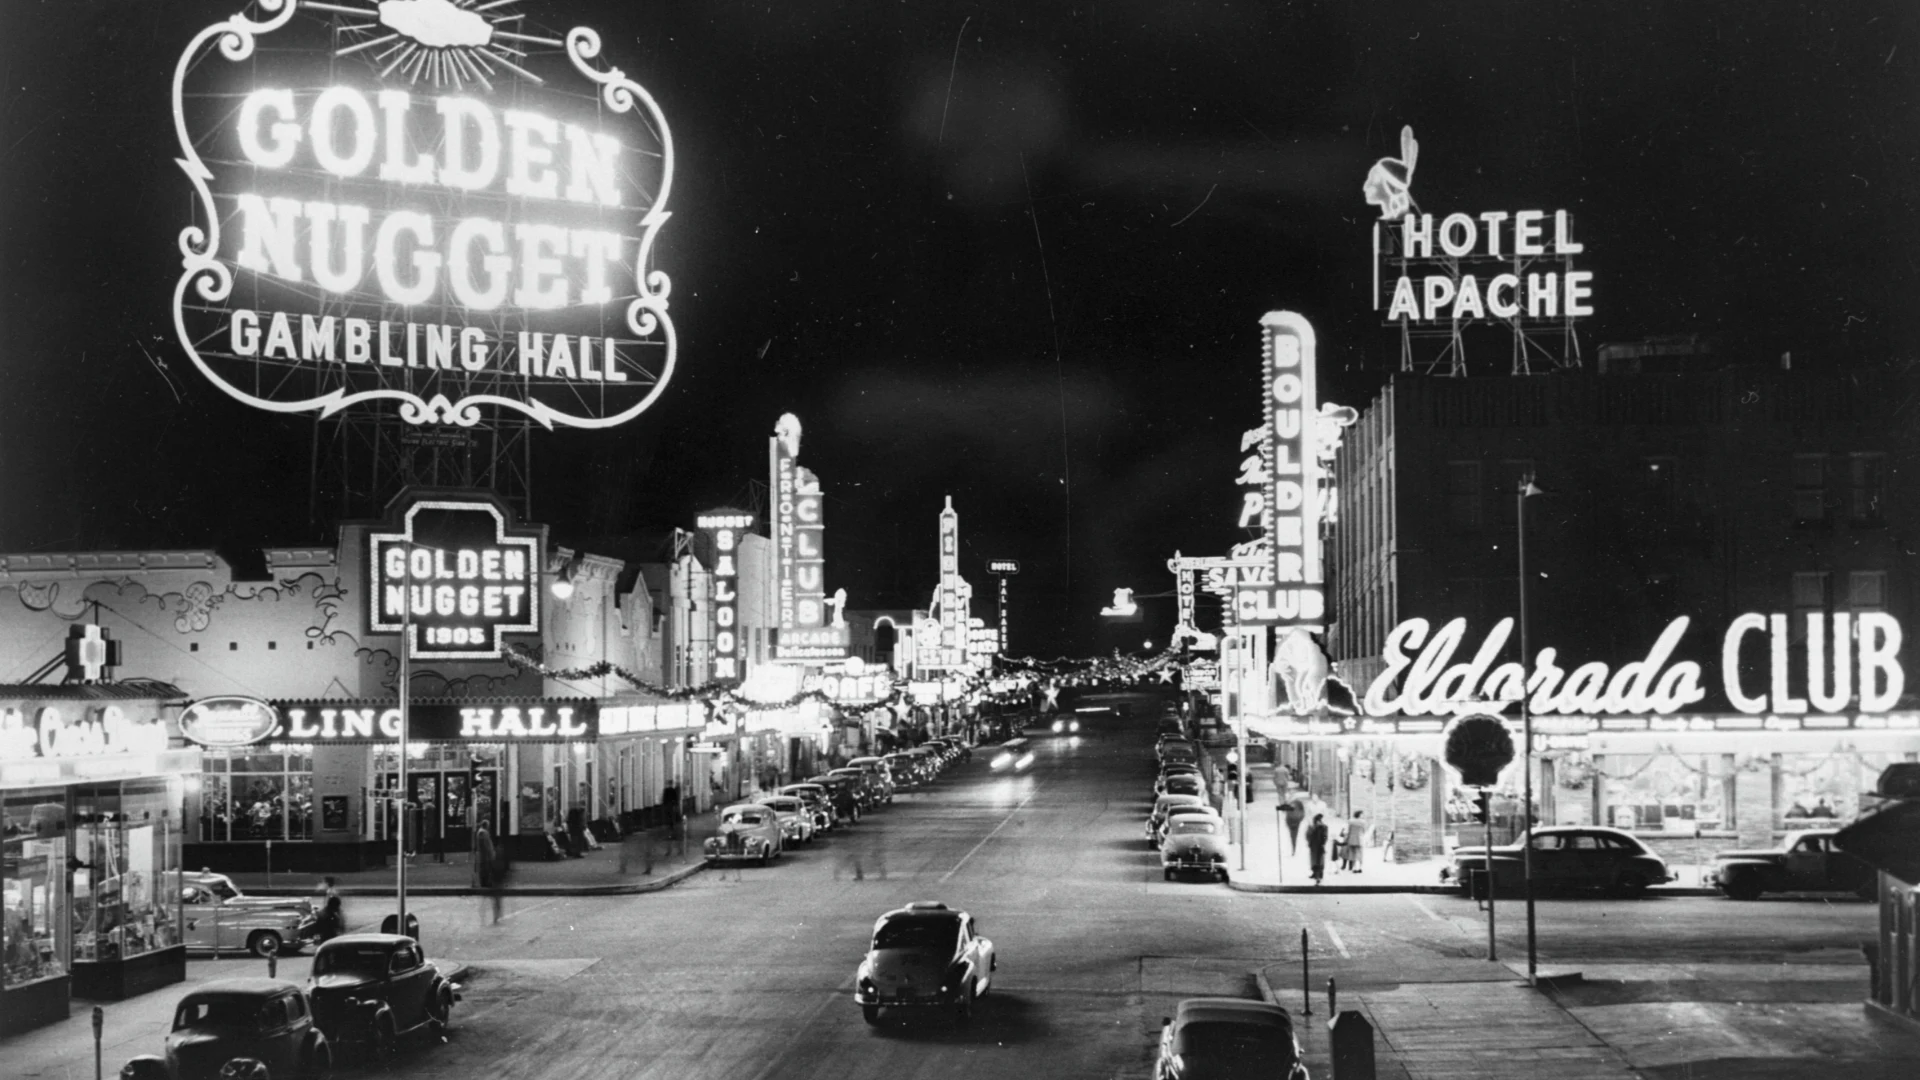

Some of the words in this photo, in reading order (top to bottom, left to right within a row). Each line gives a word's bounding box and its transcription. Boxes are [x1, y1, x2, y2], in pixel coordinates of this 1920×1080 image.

[238, 86, 622, 207] GOLDEN
[237, 193, 622, 311] NUGGET
[1404, 209, 1584, 258] HOTEL
[1388, 271, 1594, 320] APACHE
[231, 308, 488, 371] GAMBLING
[518, 332, 627, 382] HALL
[1273, 333, 1303, 582] BOULDER
[697, 515, 753, 528] NUGGET
[779, 458, 794, 621] FRONTIER
[385, 547, 525, 580] GOLDEN
[797, 499, 820, 623] CLUB
[991, 562, 1018, 571] HOTEL
[385, 585, 525, 617] NUGGET
[715, 529, 736, 678] SALOON
[1232, 589, 1325, 620] CLUB
[425, 626, 486, 645] 1905
[780, 631, 841, 646] ARCADE
[1365, 614, 1706, 717] Eldorado
[1722, 611, 1905, 714] CLUB
[459, 707, 587, 737] HALL
